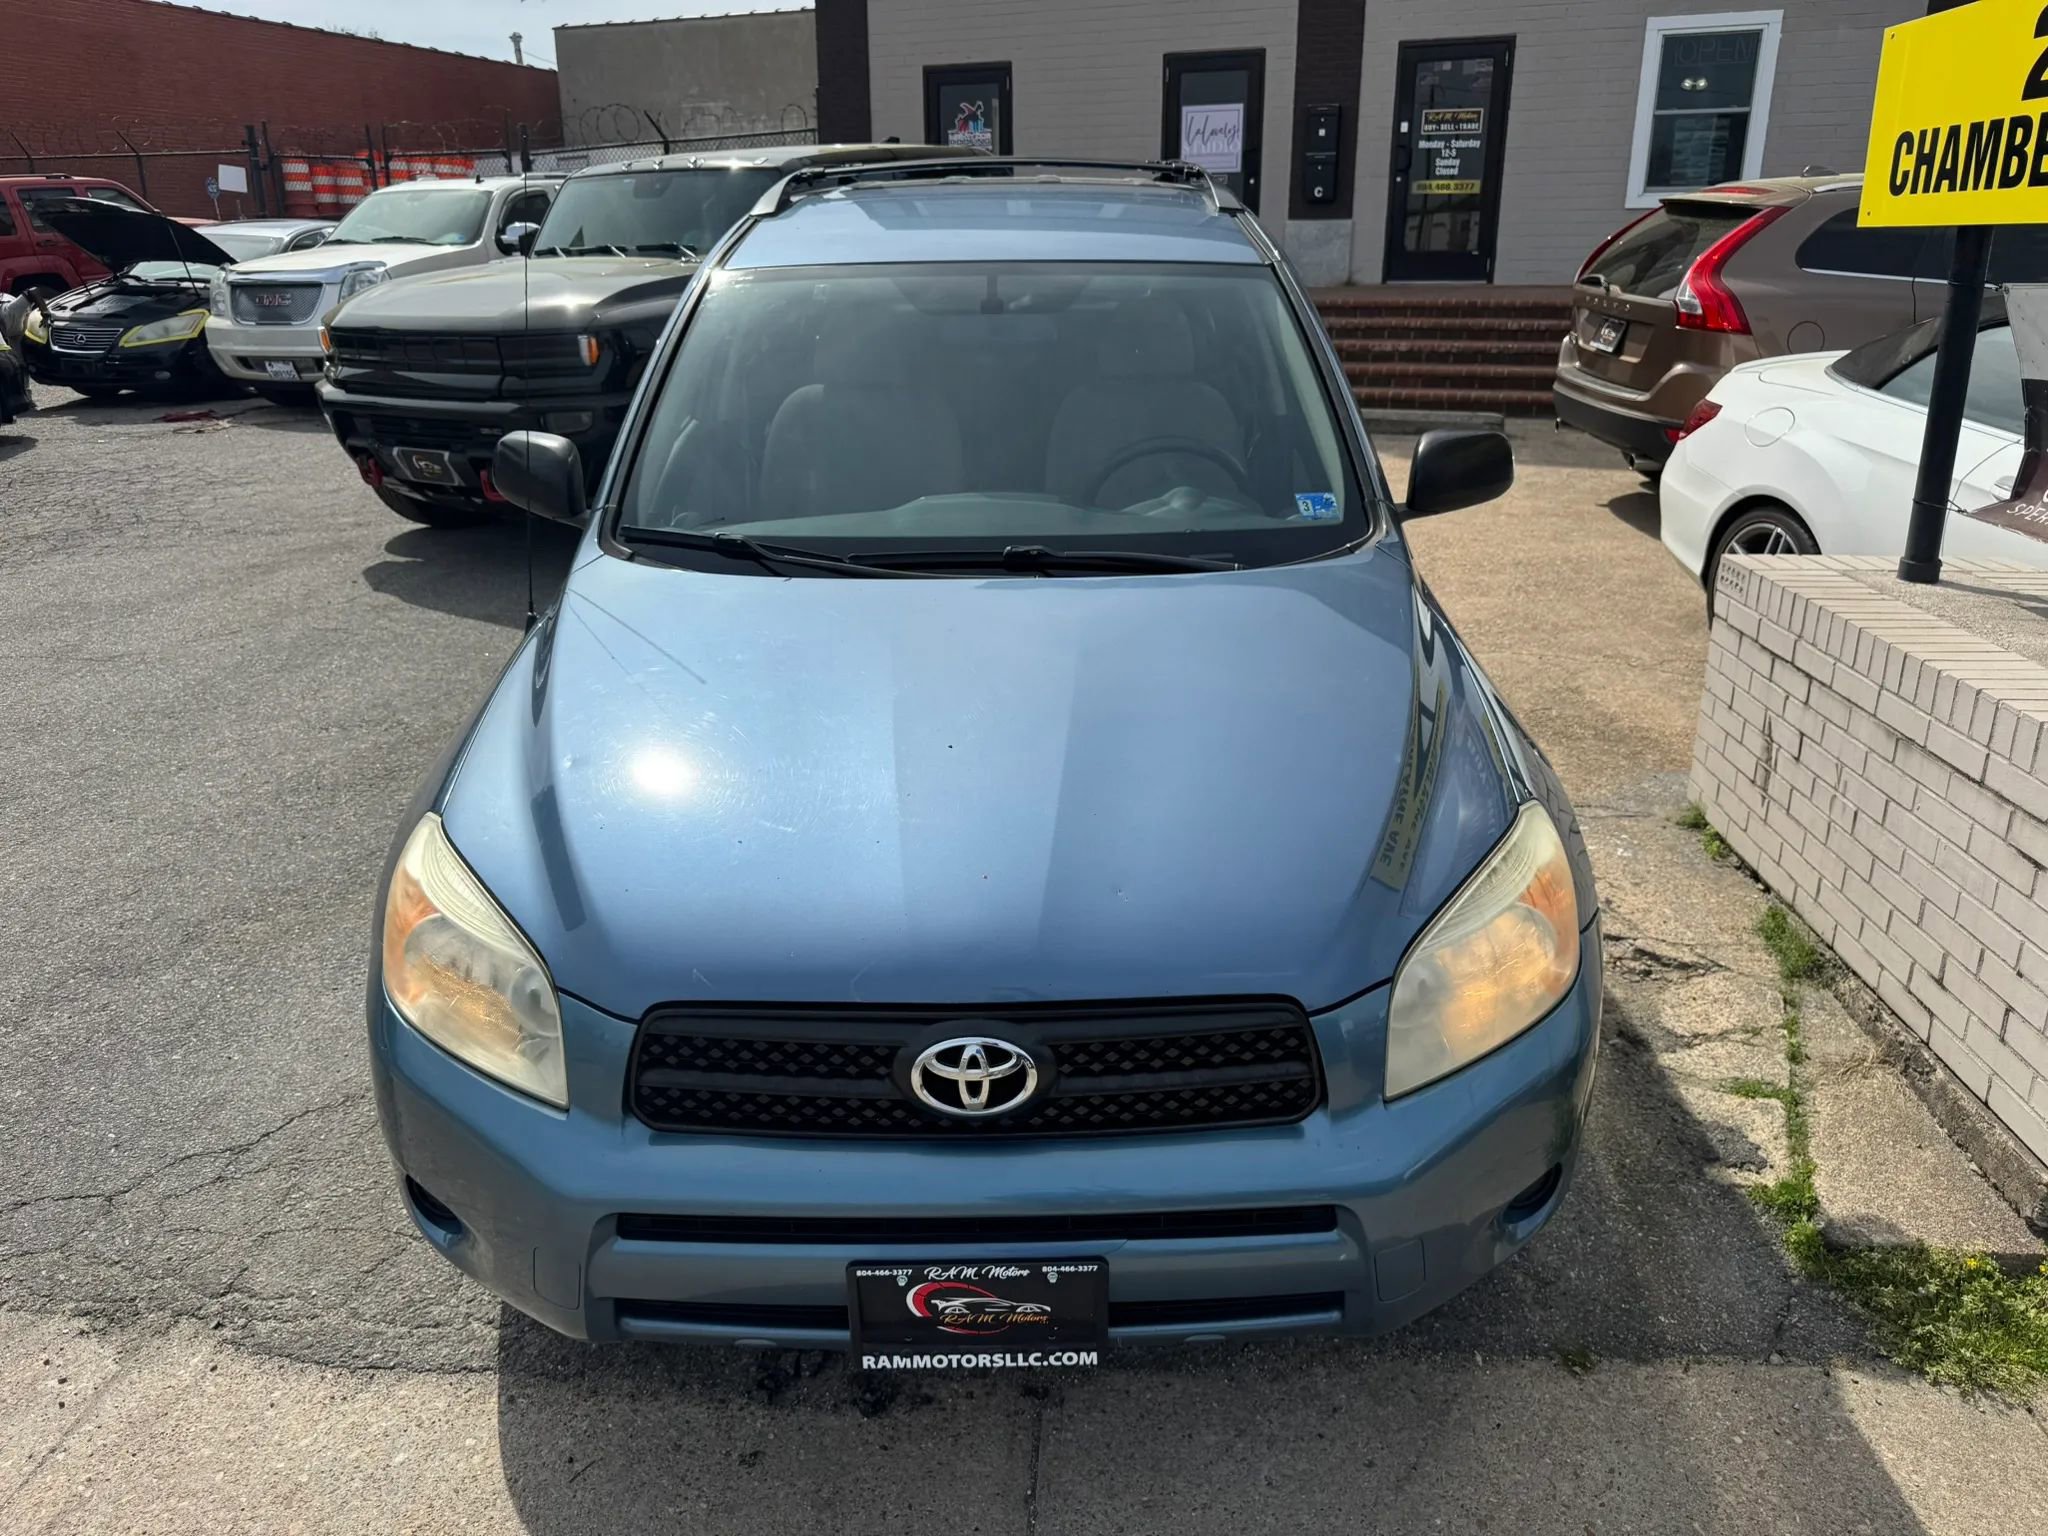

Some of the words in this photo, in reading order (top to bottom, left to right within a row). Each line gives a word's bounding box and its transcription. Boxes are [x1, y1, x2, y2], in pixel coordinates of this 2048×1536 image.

[1679, 38, 1752, 65] OPEN
[1459, 122, 1479, 130] TRADE
[1418, 140, 1446, 149] Monday
[1450, 138, 1481, 148] Saturday
[1889, 111, 2048, 197] CHAMBE
[1435, 158, 1461, 167] Sunday
[1435, 167, 1459, 176] Closed
[1302, 500, 1310, 512] 3
[856, 1268, 913, 1277] 804-466-3377
[924, 1265, 980, 1282] RAM
[981, 1264, 1030, 1281] Motors
[1042, 1265, 1098, 1273] 804-466-3377
[939, 1313, 996, 1325] RAM
[999, 1312, 1049, 1324] Motors
